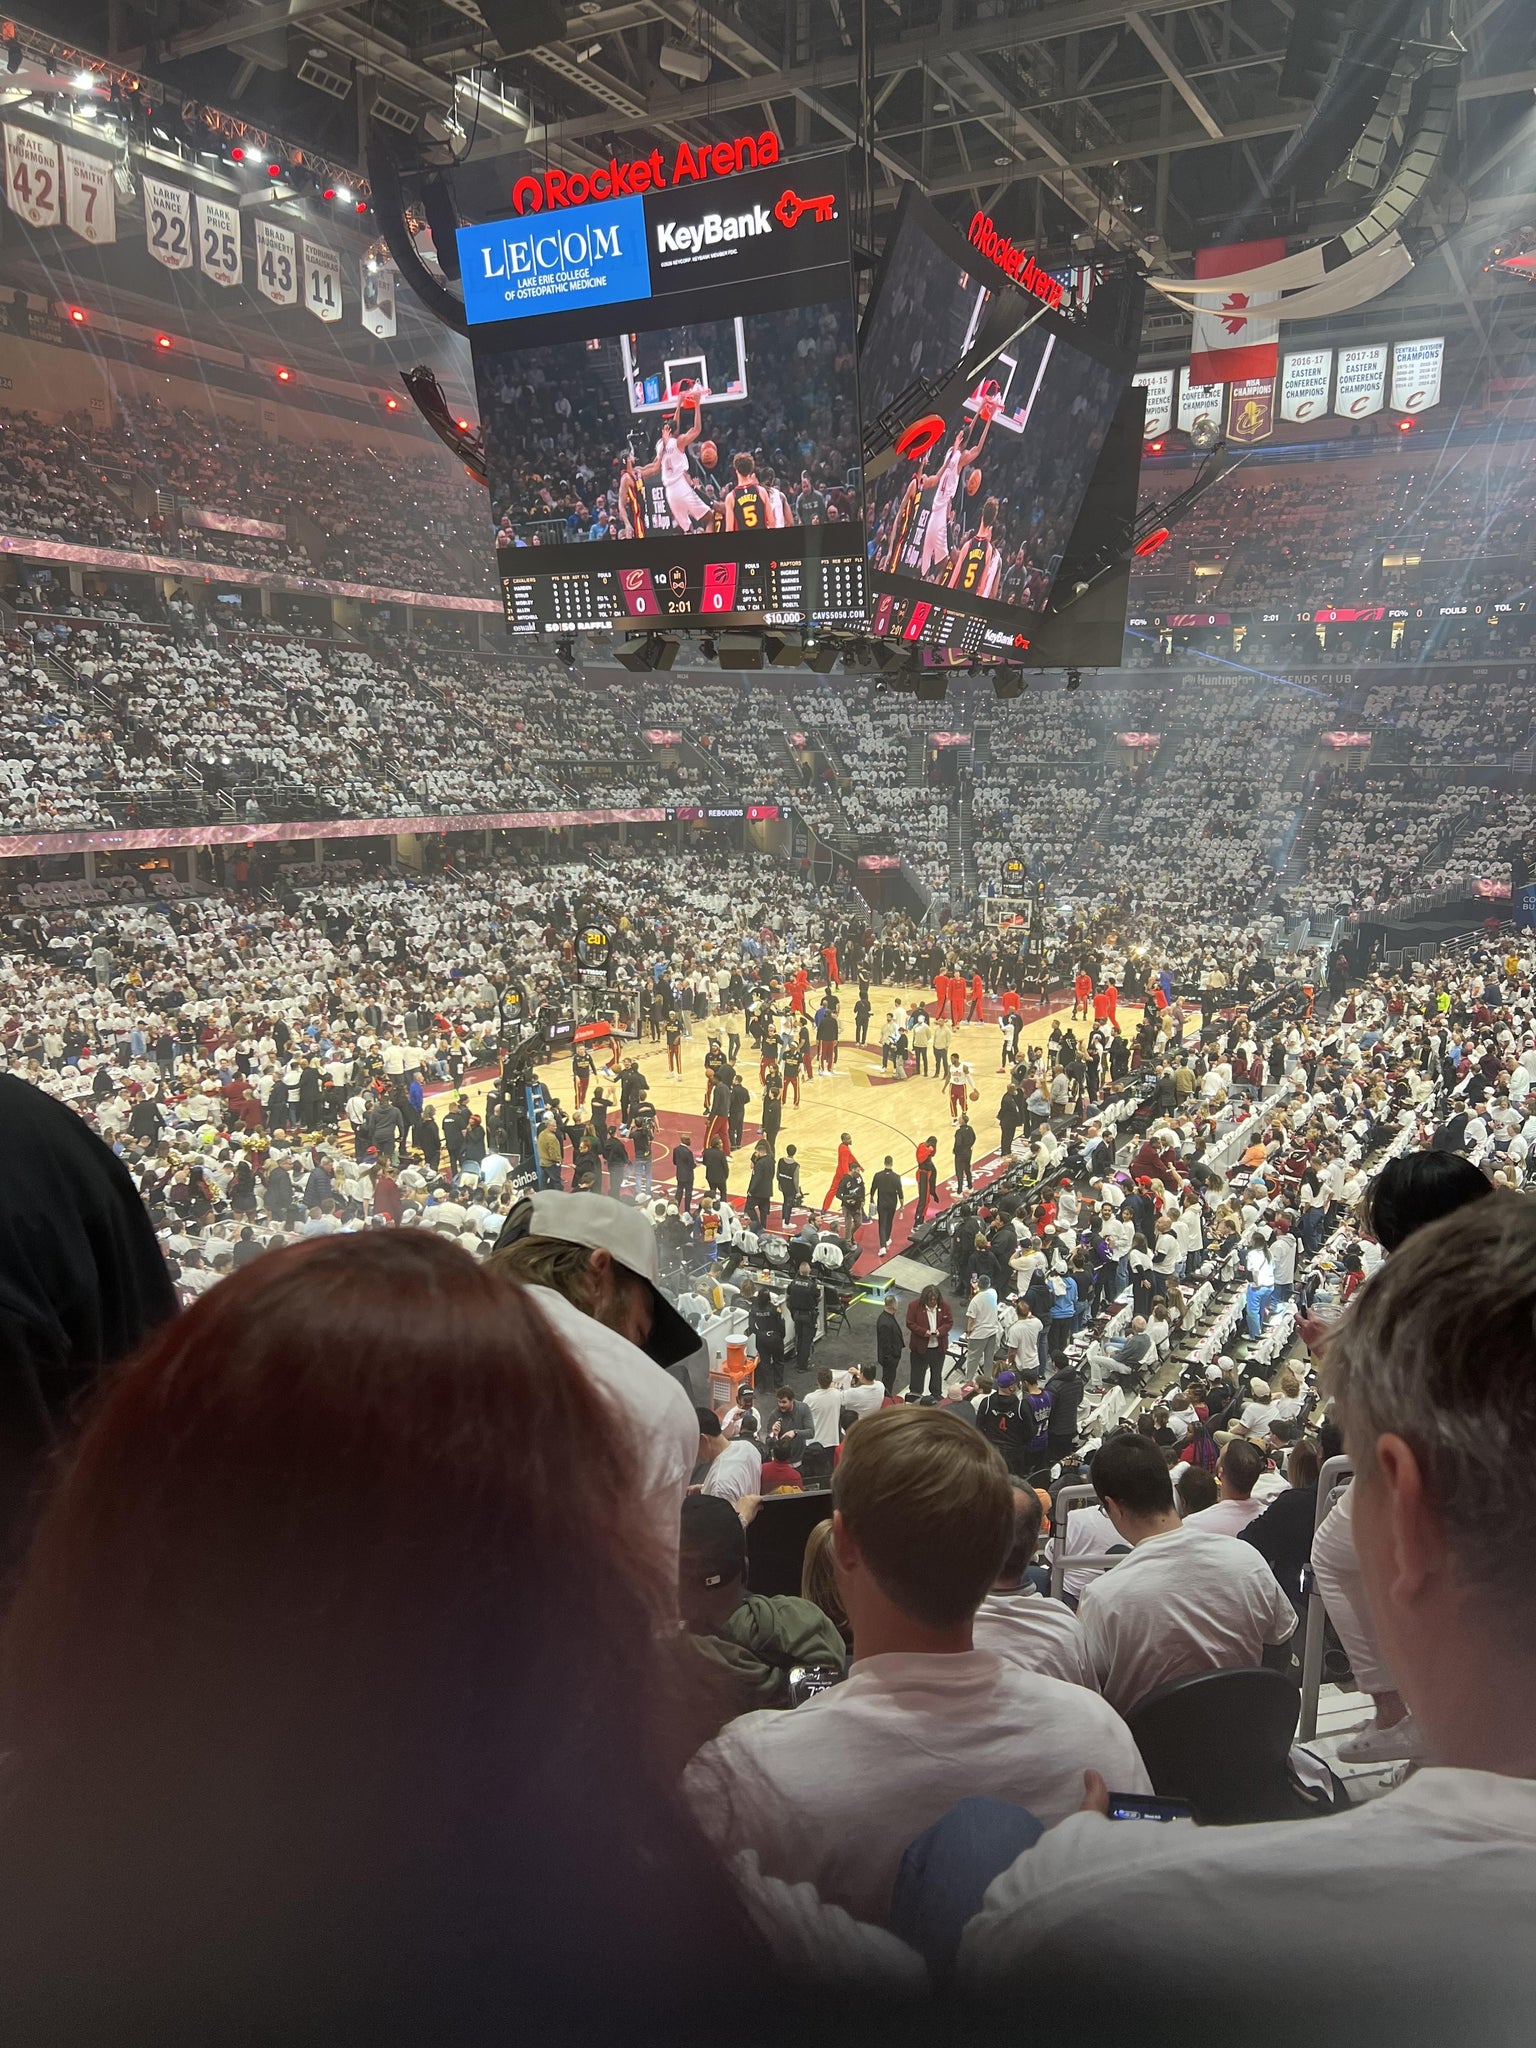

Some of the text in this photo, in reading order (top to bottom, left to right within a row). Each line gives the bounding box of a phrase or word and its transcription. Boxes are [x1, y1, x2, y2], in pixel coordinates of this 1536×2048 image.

[544, 130, 779, 209] Rocket Arena
[74, 168, 103, 186] SMITH
[13, 162, 54, 211] 42
[153, 186, 180, 202] LARRY
[82, 184, 97, 224] 7
[154, 196, 182, 214] NANCE
[206, 205, 230, 220] MARK
[207, 216, 231, 231] PRICE
[657, 205, 772, 253] KeyBank
[152, 210, 187, 255] 22
[265, 227, 285, 241] BRAD
[204, 229, 238, 272] 25
[262, 250, 292, 291] 43
[977, 217, 1064, 311] Rocket Arena
[518, 268, 590, 288] LAKE ERIE COLLEGE
[312, 269, 335, 307] 11
[505, 276, 607, 301] OF OSTEOPATHIC MEDICINE
[1291, 355, 1323, 366] 2016-17
[1345, 350, 1379, 362] 2017-18
[1397, 350, 1439, 362] CHAMPIONS
[1292, 367, 1321, 379] EASTERN
[1346, 362, 1377, 373] EASTERN
[1139, 376, 1168, 386] 2014-15
[1246, 379, 1260, 387] NBA
[1285, 377, 1327, 389] CONFERENCE
[1339, 372, 1383, 384] CONFERENCE
[1147, 387, 1166, 397] STERN
[1181, 389, 1221, 401] CONFERENCE
[1233, 384, 1272, 397] CHAMPIONS
[1286, 387, 1324, 399] CHAMPIONS
[1340, 382, 1380, 394] CHAMPIONS
[1148, 396, 1171, 406] ERENCE
[1182, 400, 1218, 411] CHAMPIONS
[1146, 406, 1169, 415] MPIONS
[652, 487, 664, 500] GET
[653, 500, 666, 513] THE
[743, 505, 758, 527] 5
[654, 574, 667, 584] 1Q
[964, 563, 978, 589] 5
[636, 597, 645, 612] 0
[668, 601, 691, 613] 2:01
[713, 593, 722, 608] 0
[765, 610, 865, 624] $10,000 CAVS5050.COM
[1154, 618, 1160, 626] 0
[1208, 615, 1215, 625] 0
[1263, 614, 1279, 622] 2:01
[1297, 612, 1311, 622] 1Q
[1329, 612, 1337, 621] 0
[1416, 609, 1423, 617] 0
[1440, 607, 1467, 615] FOULS
[1475, 606, 1482, 614] 0
[1494, 604, 1512, 612] TOL
[1519, 603, 1526, 612] 7
[578, 621, 613, 630] RAFFLE
[984, 628, 1014, 647] KeyBank
[1198, 674, 1256, 688] Huntington
[708, 809, 743, 817] REBOUNDS
[752, 809, 757, 817] 0
[512, 1170, 538, 1189] oinba
[998, 1417, 1008, 1431] 4
